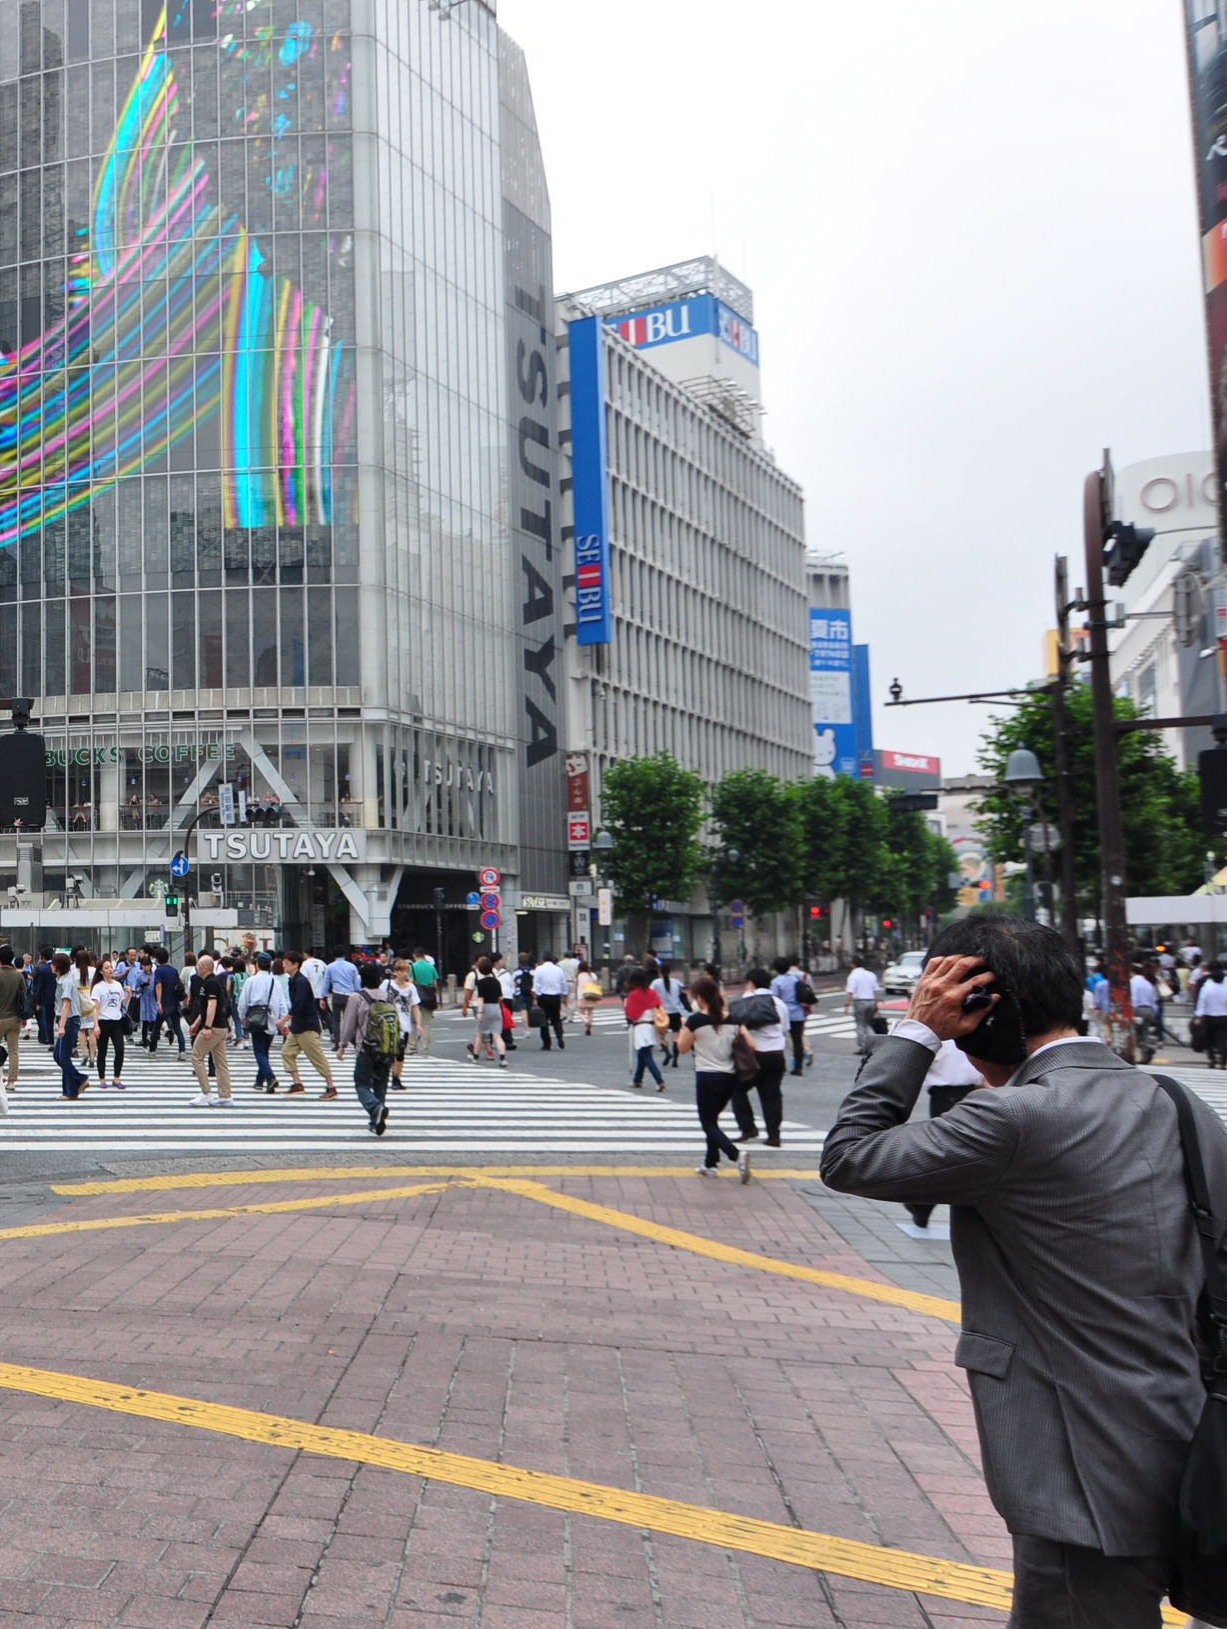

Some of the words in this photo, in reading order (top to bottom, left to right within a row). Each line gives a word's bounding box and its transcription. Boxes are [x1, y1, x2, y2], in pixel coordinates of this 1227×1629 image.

[610, 305, 691, 346] IBU
[515, 284, 559, 768] TSUTAYA
[576, 534, 603, 625] SEIBU
[139, 743, 235, 763] COFFEE
[424, 760, 494, 794] TSUTAYA
[204, 832, 359, 860] TSUTAYA
